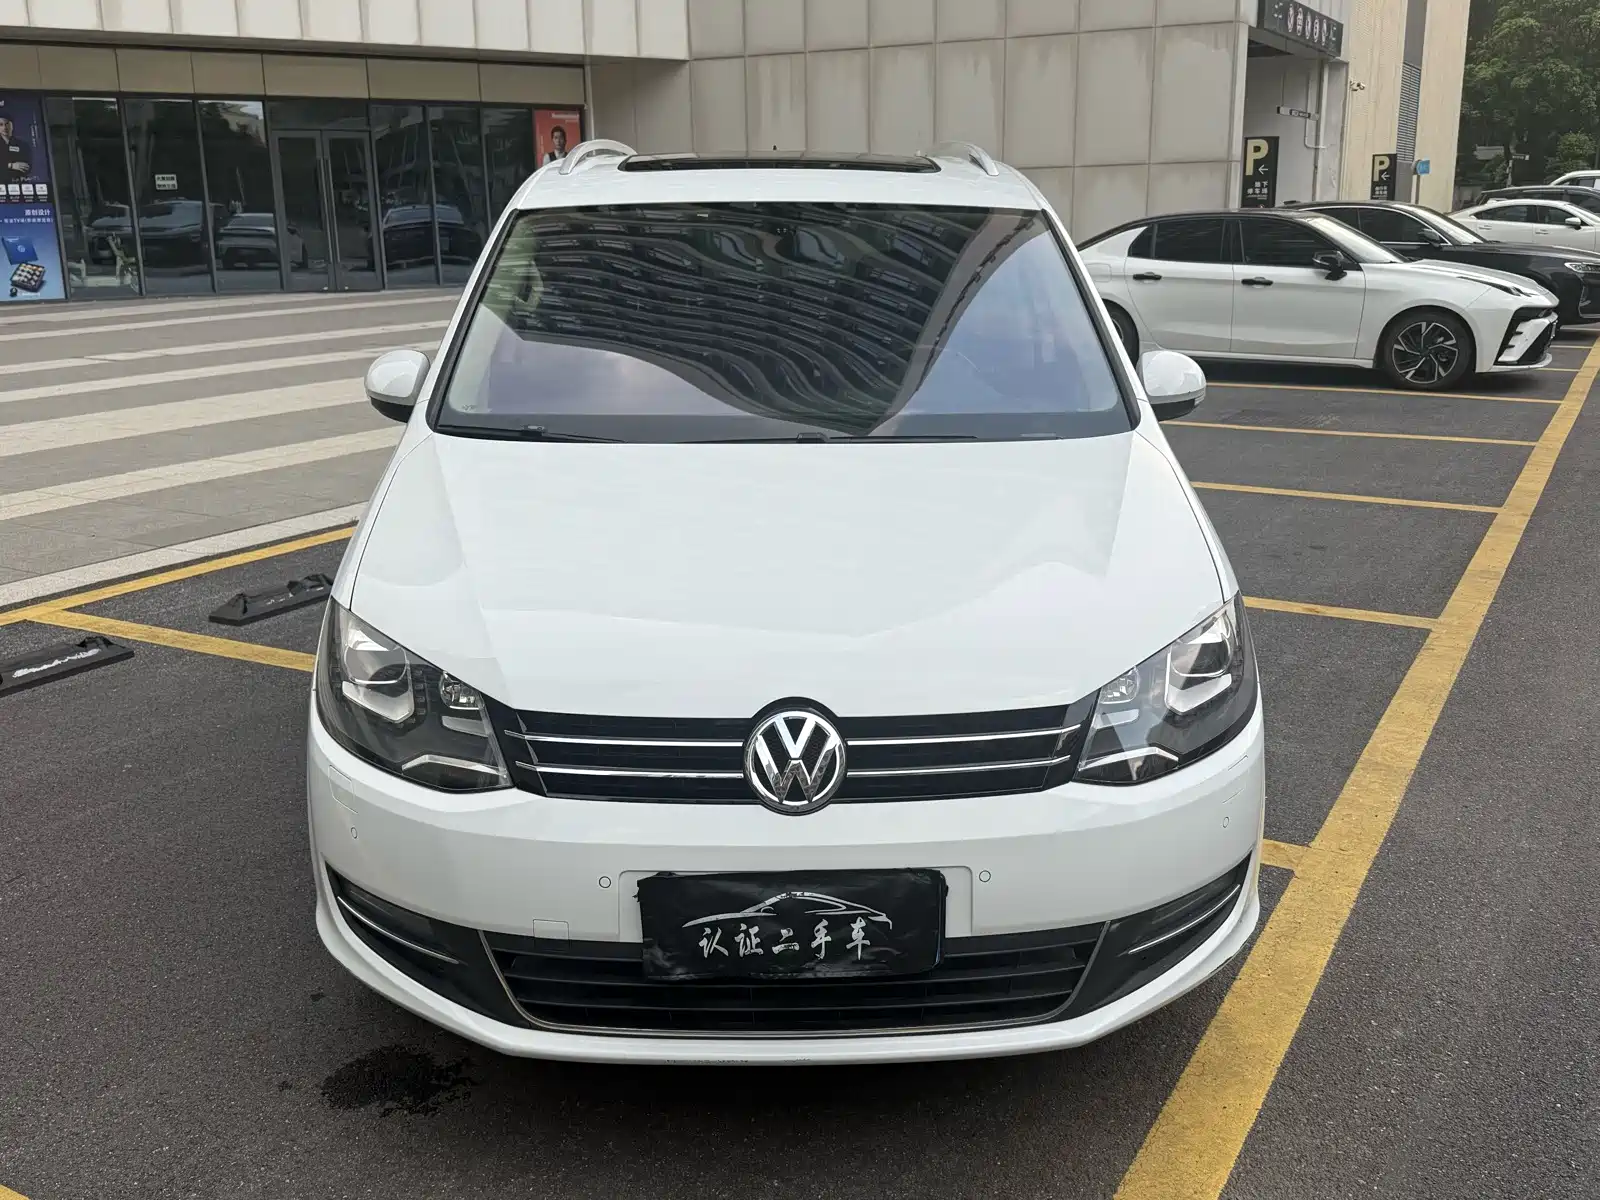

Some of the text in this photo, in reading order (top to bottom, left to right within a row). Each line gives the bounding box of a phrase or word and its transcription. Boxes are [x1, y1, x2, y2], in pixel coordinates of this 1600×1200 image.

[1245, 138, 1269, 176] P
[1373, 155, 1390, 182] P
[698, 916, 871, 961] 认证二手车
